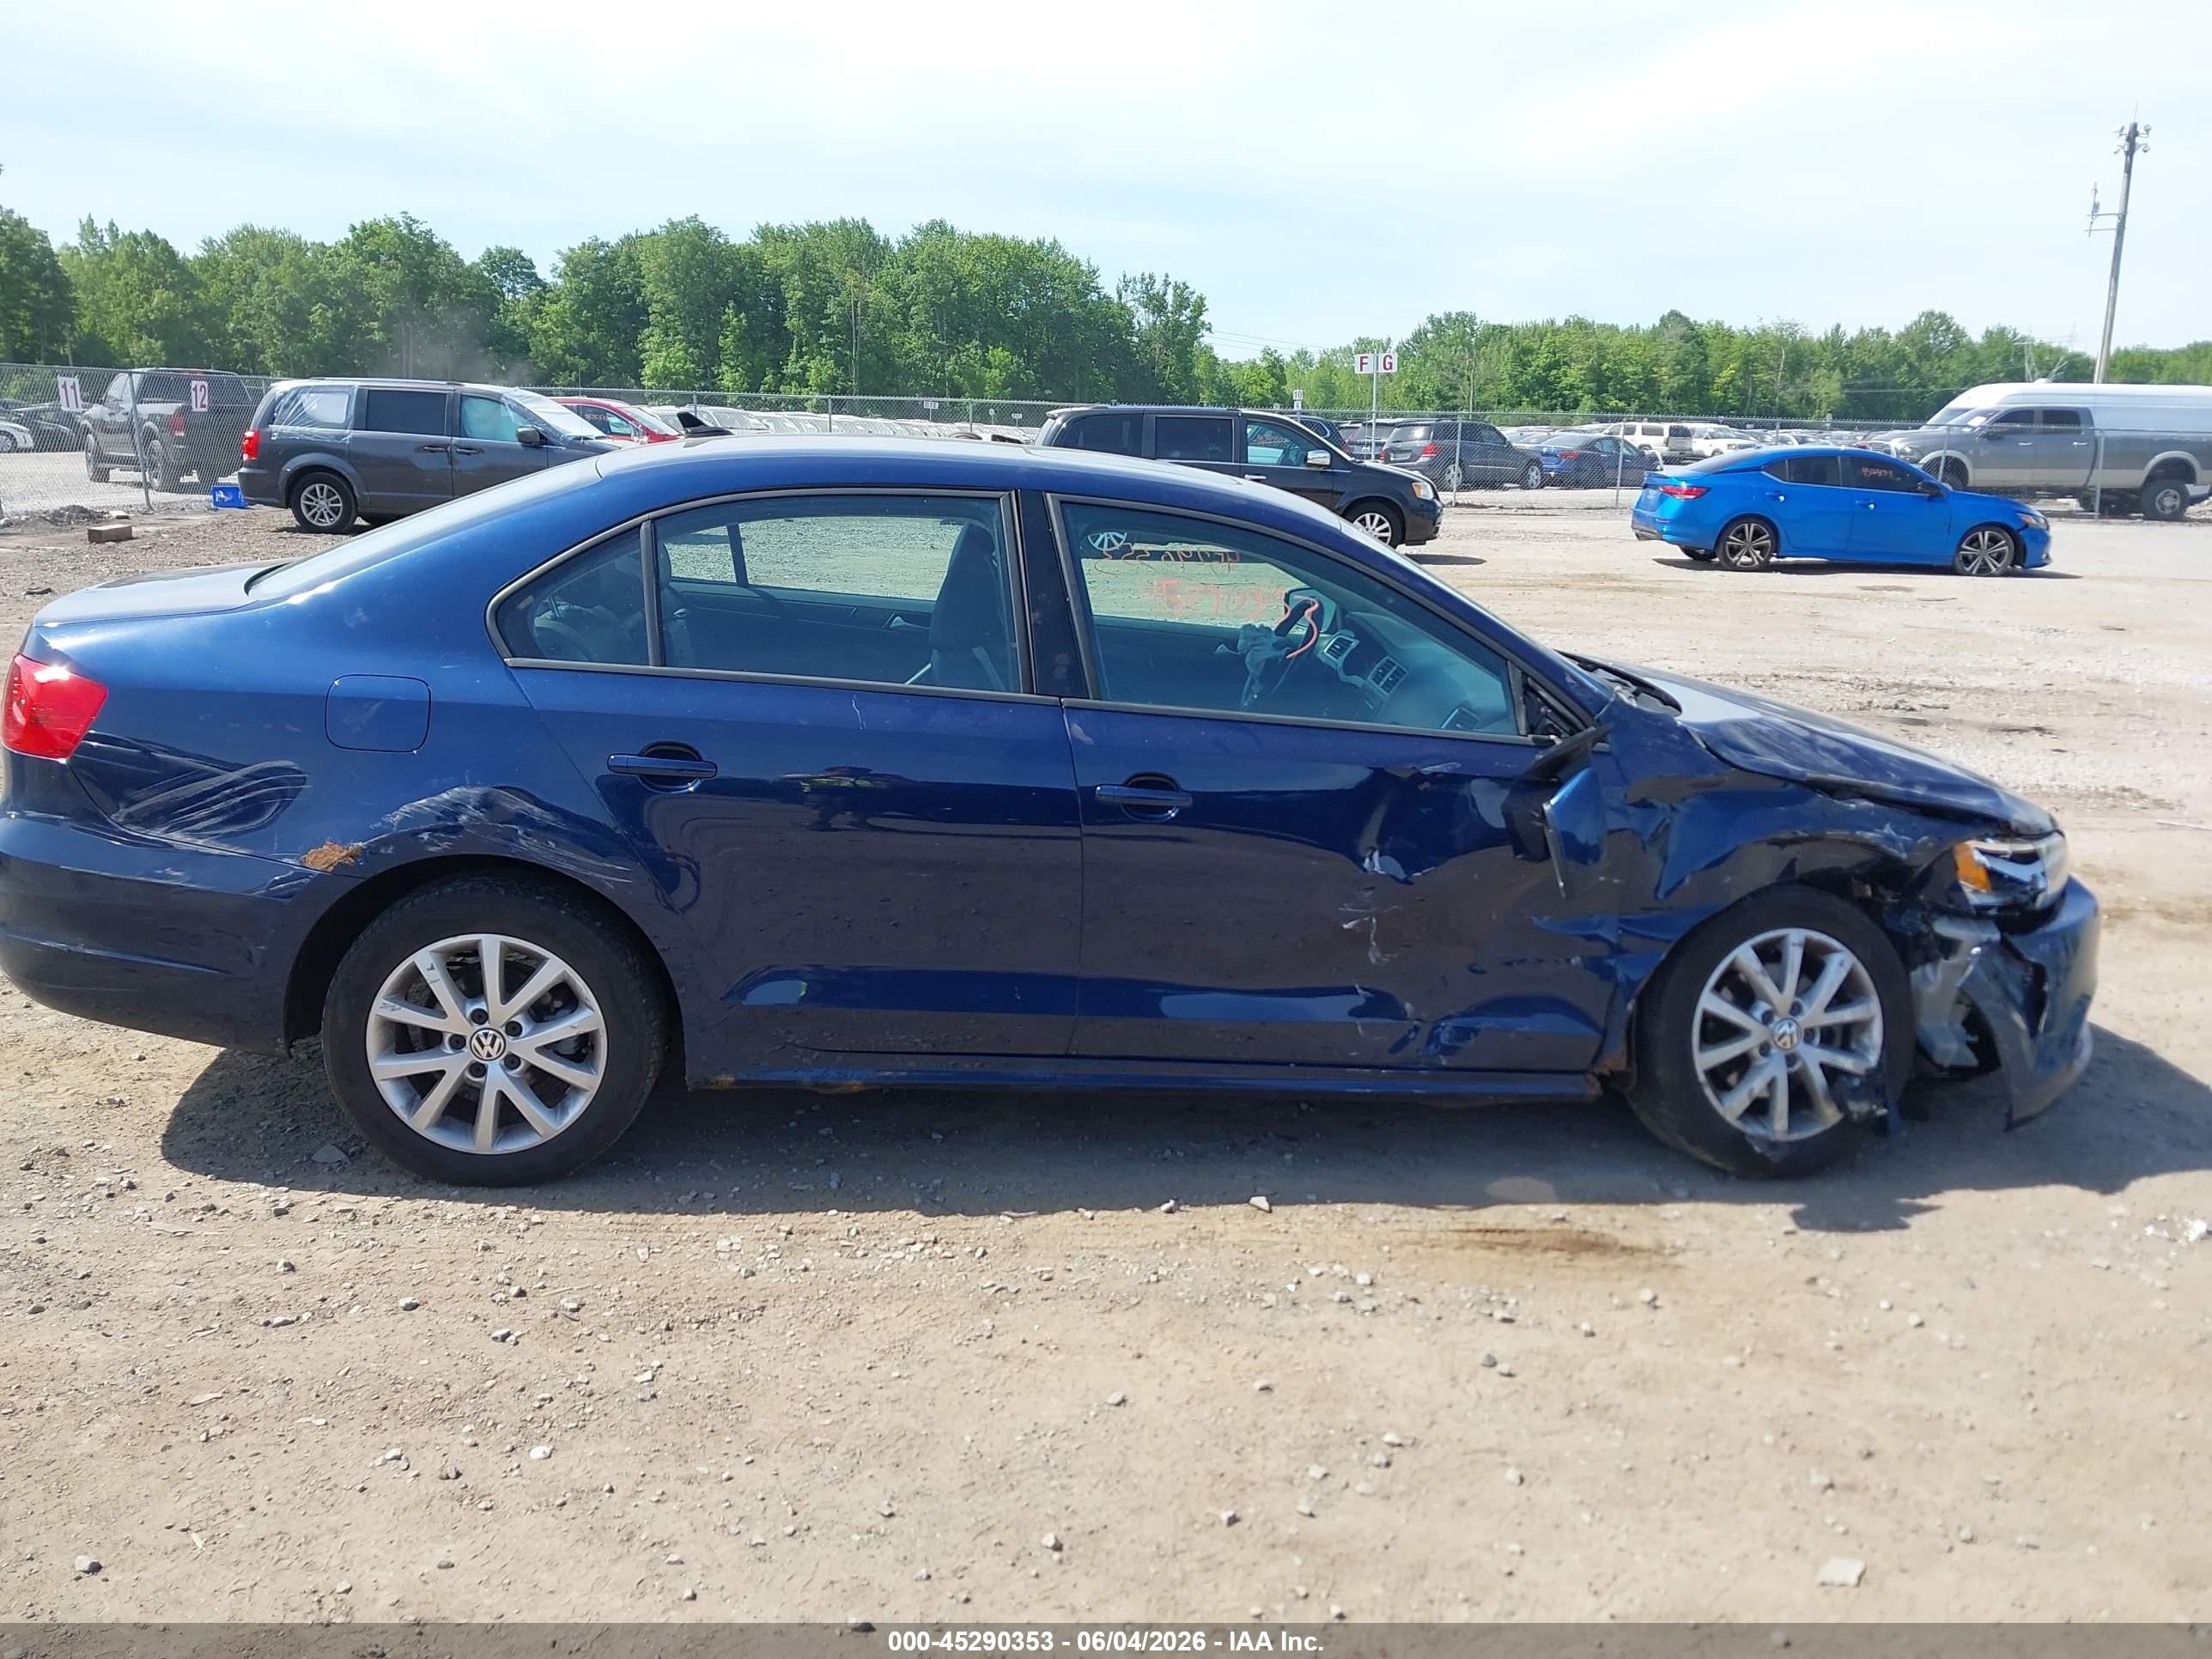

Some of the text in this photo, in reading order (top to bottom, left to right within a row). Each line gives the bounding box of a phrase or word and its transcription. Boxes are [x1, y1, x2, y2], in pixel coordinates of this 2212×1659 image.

[1359, 356, 1369, 372] F
[1382, 354, 1394, 371] G
[61, 380, 80, 409] 11
[192, 384, 207, 409] 12
[471, 1030, 505, 1060] VW
